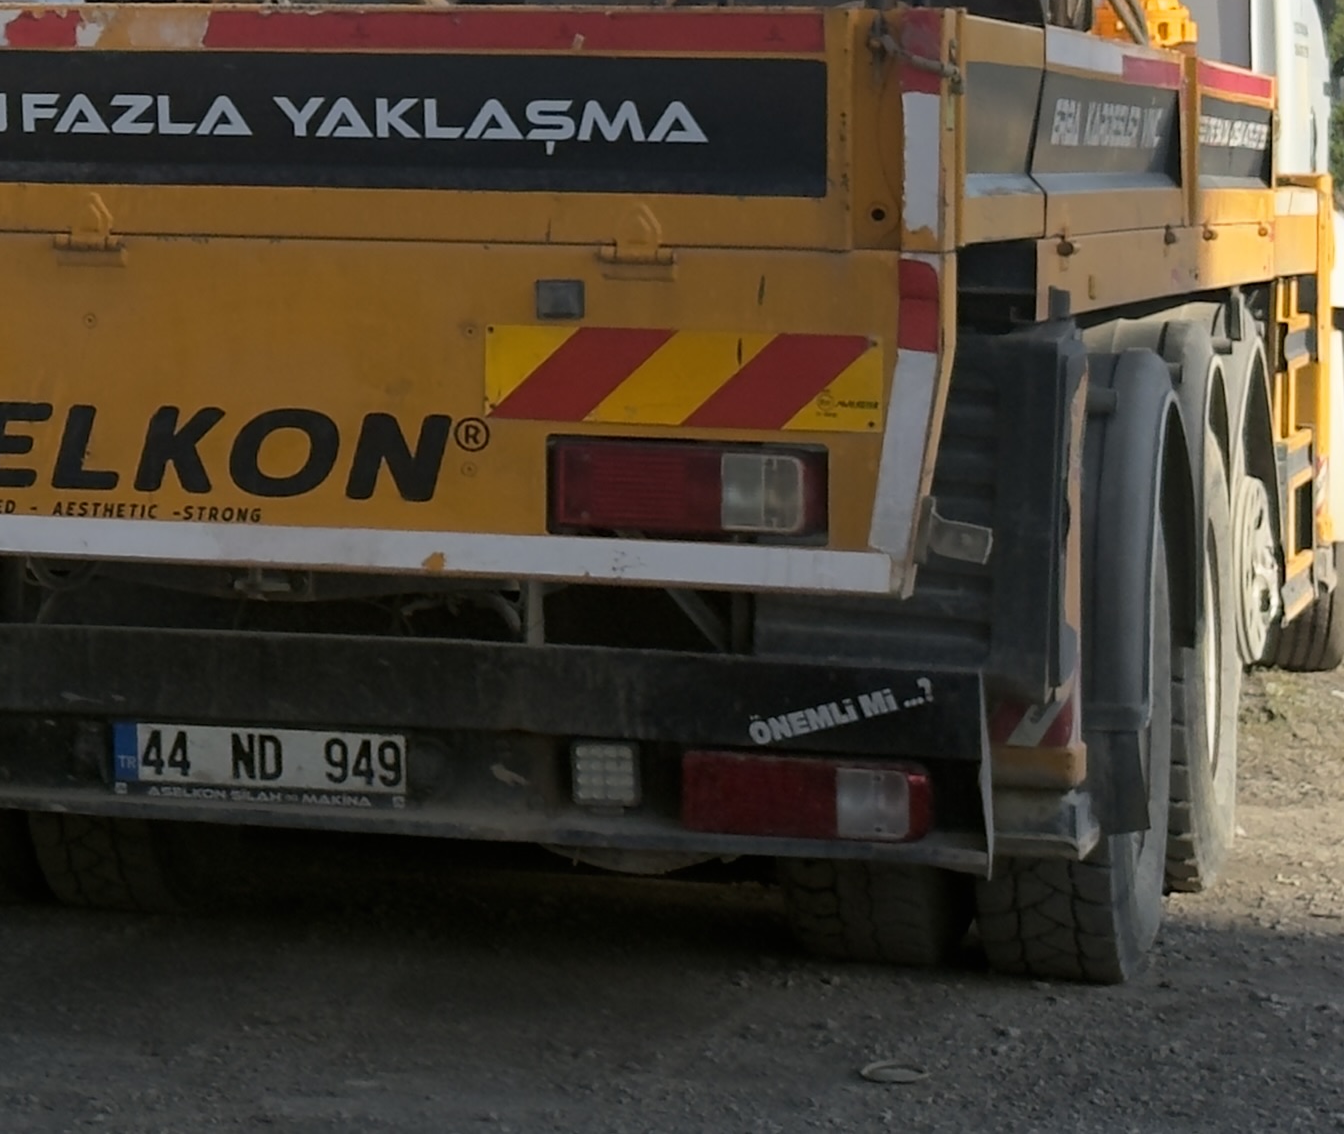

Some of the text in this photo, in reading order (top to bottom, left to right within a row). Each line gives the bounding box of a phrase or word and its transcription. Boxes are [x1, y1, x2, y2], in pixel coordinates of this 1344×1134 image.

[21, 92, 253, 136] FAZLA
[272, 95, 710, 156] YAKLAŞMA
[52, 501, 160, 520] AESTHETIC
[117, 755, 137, 769] TR
[141, 729, 403, 788] 44 ND 949
[146, 785, 227, 801] ASELKON
